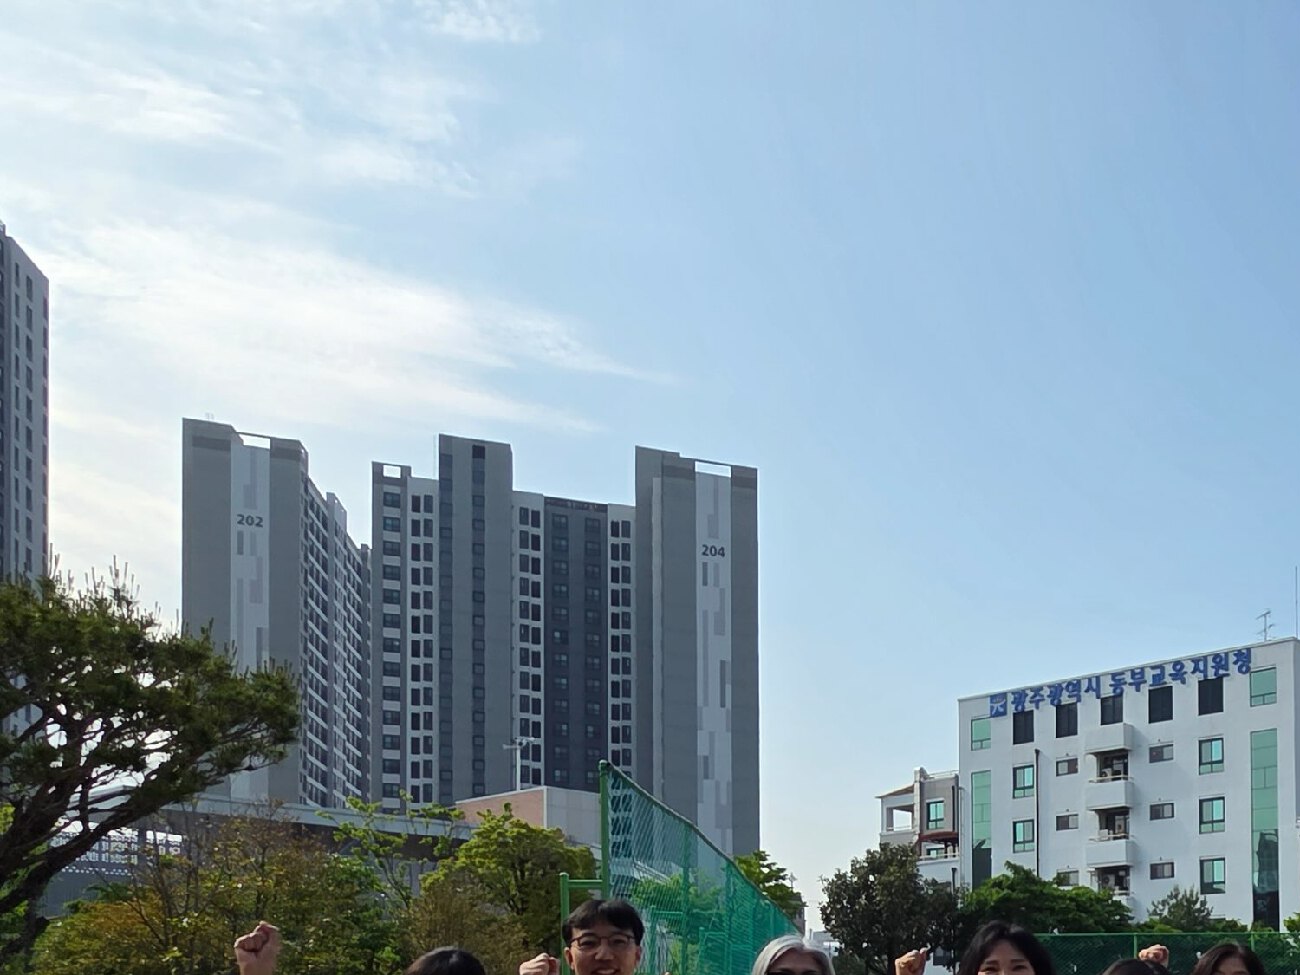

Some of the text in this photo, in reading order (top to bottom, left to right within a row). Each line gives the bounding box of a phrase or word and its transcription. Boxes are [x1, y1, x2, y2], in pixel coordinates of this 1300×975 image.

[237, 514, 264, 528] 202
[702, 544, 725, 557] 204
[1011, 647, 1252, 713] 광주광역시 동부교육지원청
